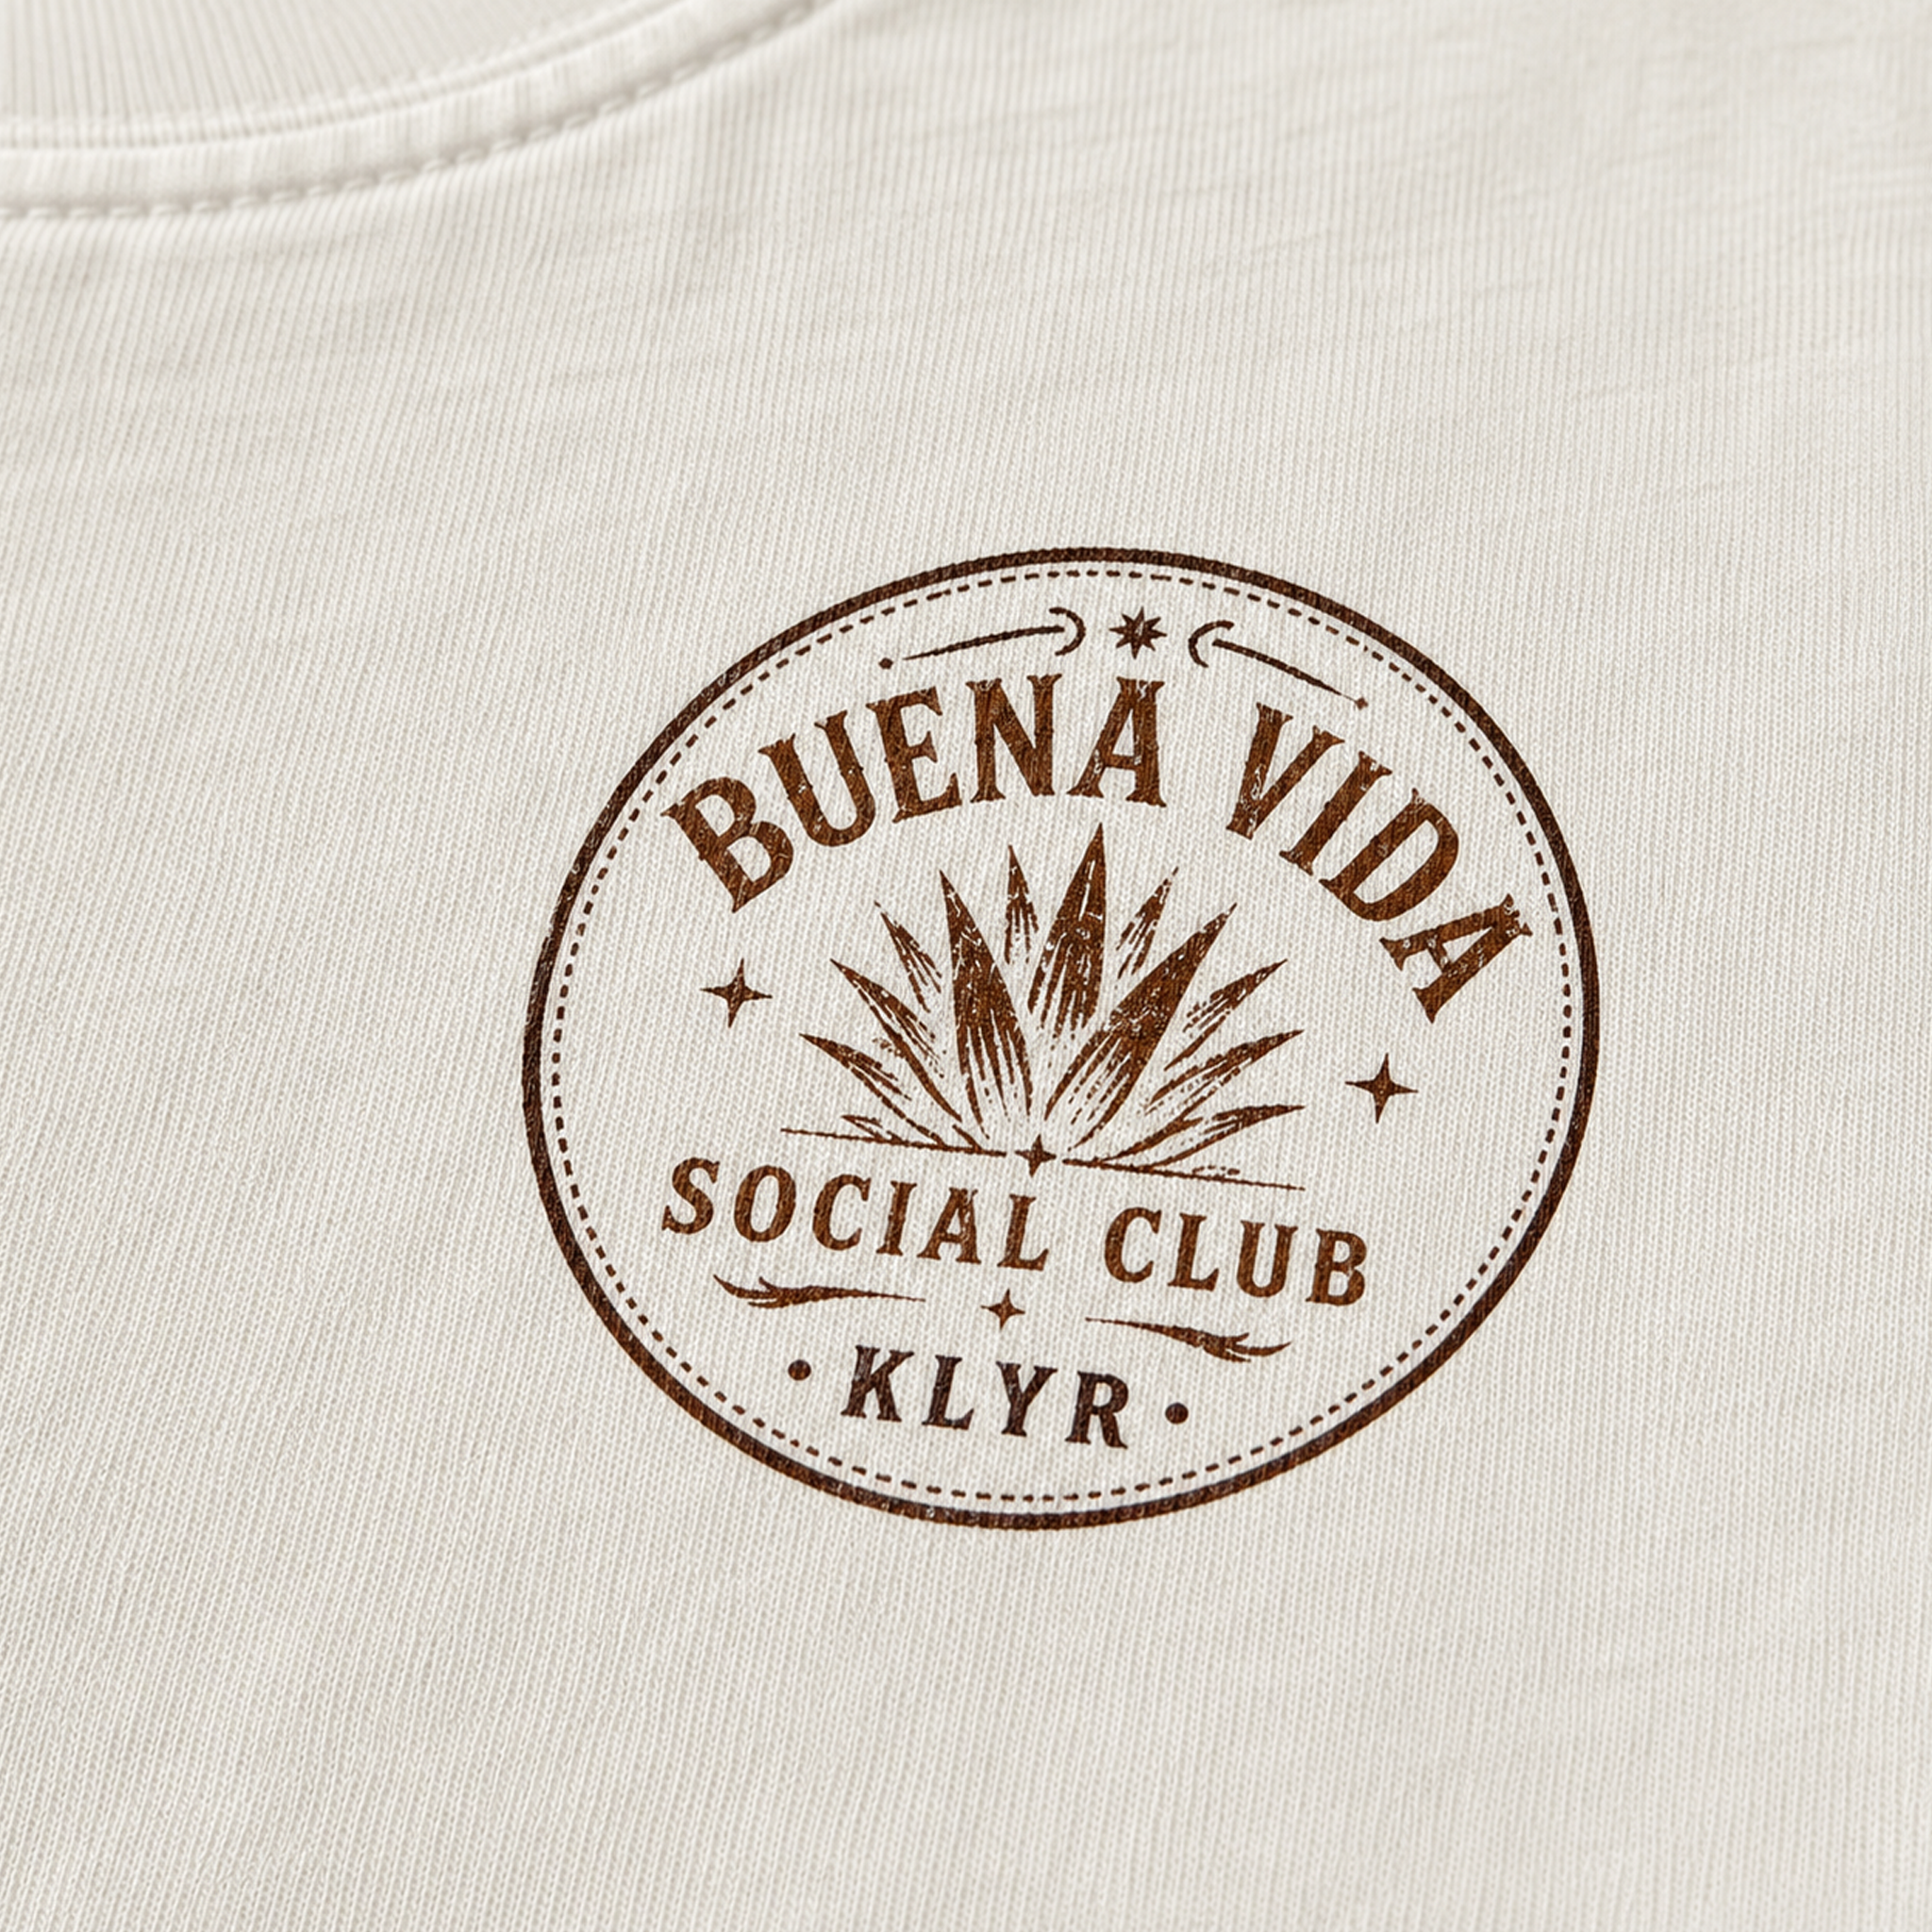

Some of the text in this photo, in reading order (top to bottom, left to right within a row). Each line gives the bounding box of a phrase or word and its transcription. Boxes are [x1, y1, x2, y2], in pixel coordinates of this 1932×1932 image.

[661, 674, 1532, 1023] BUENA VIDA
[661, 1157, 1367, 1307] SOCIAL CLUB
[841, 1344, 1129, 1450] KLYR
